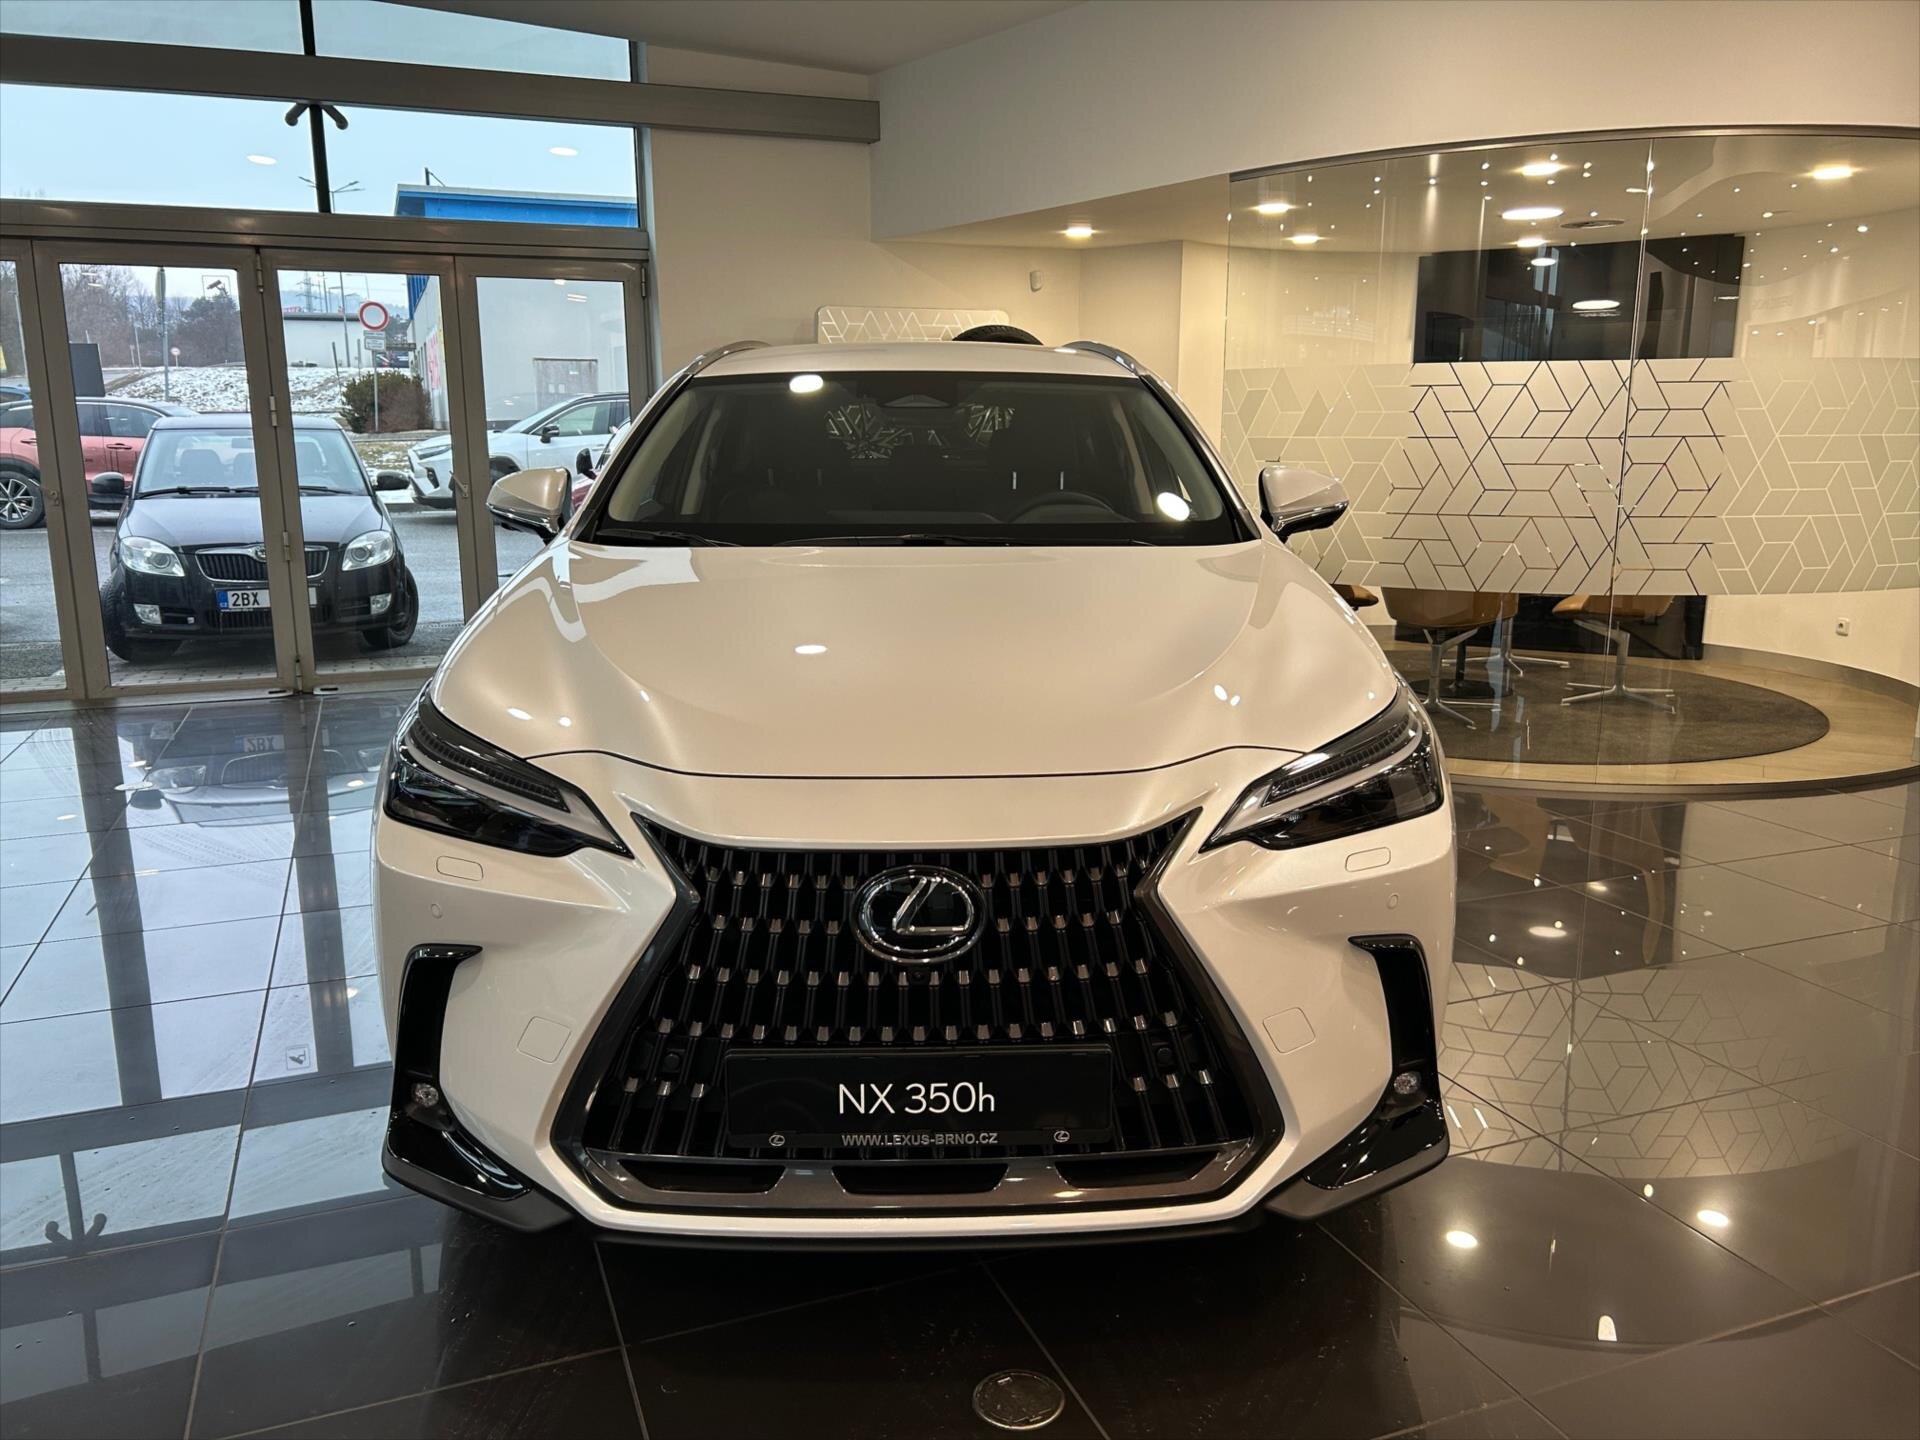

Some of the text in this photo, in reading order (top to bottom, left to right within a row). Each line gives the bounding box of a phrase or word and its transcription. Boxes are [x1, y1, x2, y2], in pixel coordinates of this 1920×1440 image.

[231, 592, 260, 607] 2BX
[838, 1081, 995, 1114] NX 350h
[841, 1132, 998, 1147] WWW.LEXUS-BRNO.CZ
